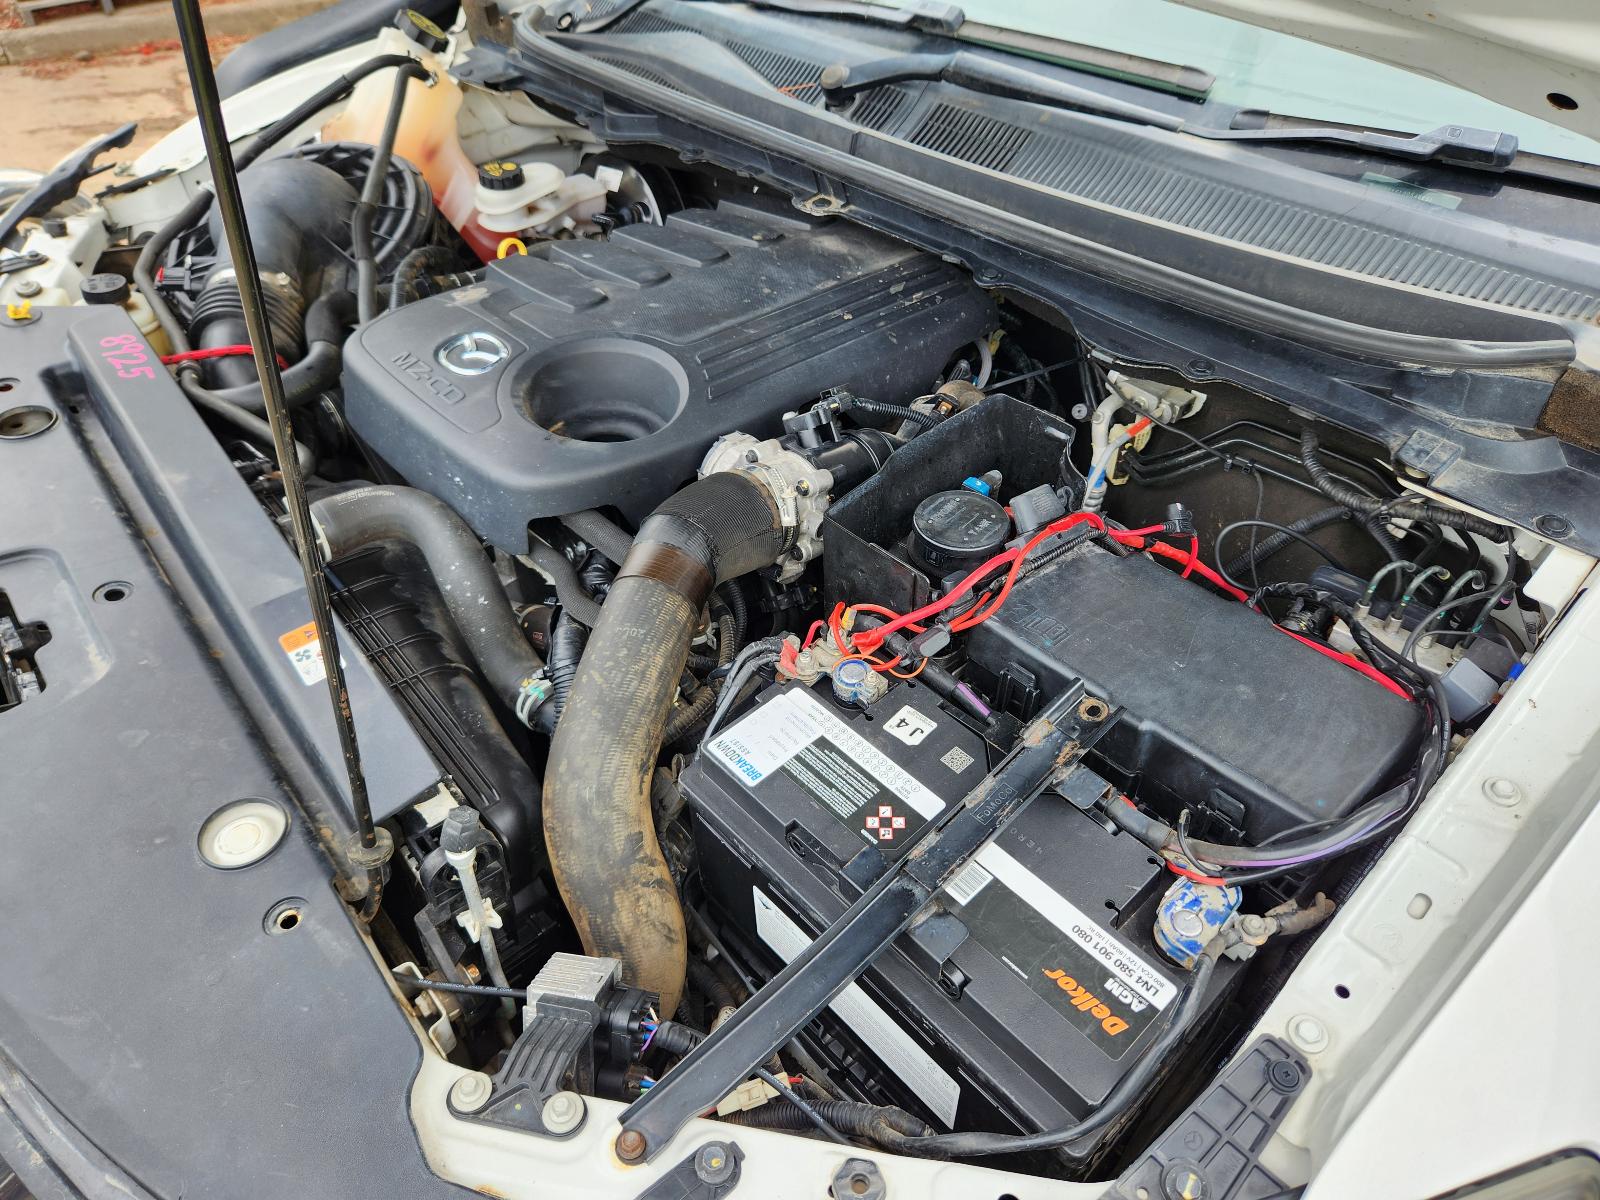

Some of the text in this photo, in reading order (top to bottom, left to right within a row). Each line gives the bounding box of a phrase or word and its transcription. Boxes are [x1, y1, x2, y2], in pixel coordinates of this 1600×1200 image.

[98, 331, 156, 380] 8925
[713, 738, 763, 782] BREAKDOWN
[728, 737, 751, 755] ASSIST
[975, 787, 1012, 821] FoMoCo
[1070, 924, 1159, 996] LN4 580 901 080
[1043, 966, 1129, 1036] Delkor
[1103, 976, 1147, 1012] AGM
